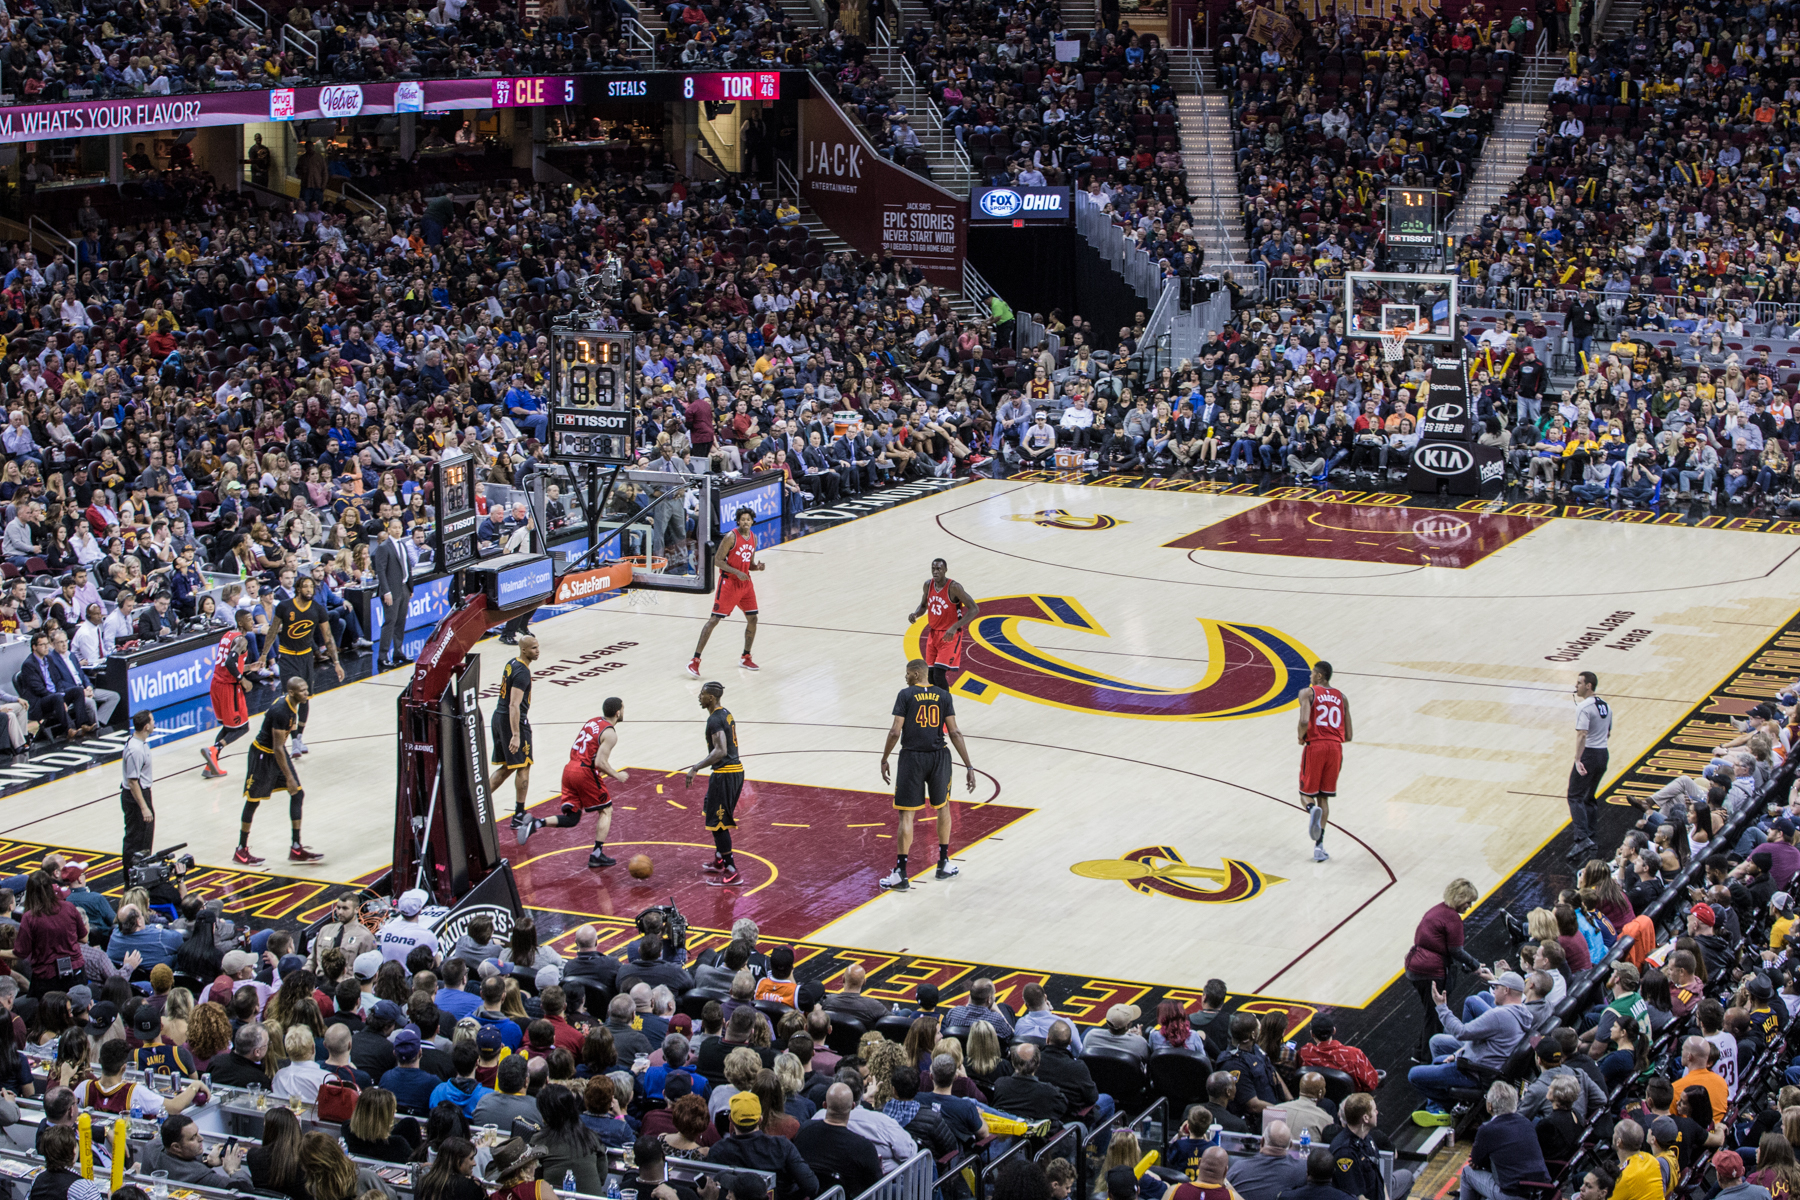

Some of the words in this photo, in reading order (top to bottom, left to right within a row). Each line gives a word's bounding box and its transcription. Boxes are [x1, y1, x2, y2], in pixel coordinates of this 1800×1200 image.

[496, 80, 510, 90] FG%
[608, 81, 647, 96] STEALS
[683, 77, 694, 98] 8
[722, 76, 753, 97] TOR
[760, 74, 775, 83] FG%
[272, 92, 291, 105] drug
[323, 87, 360, 112] Velvet
[497, 90, 509, 105] 37
[515, 79, 545, 104] CLE
[564, 80, 574, 102] 5
[760, 83, 774, 97] 46
[21, 109, 84, 135] WHAT'S
[88, 106, 131, 129] YOUR
[136, 101, 202, 126] FLAVOR?
[274, 105, 294, 117] mart
[811, 181, 858, 194] ENTERTAINMENT
[990, 194, 1013, 206] FOX
[883, 211, 907, 228] EPIC
[910, 213, 955, 231] STORIES
[883, 229, 908, 241] NEVER
[910, 231, 933, 243] START
[935, 232, 955, 244] WITH
[1401, 235, 1433, 243] TISSOT
[893, 243, 912, 251] DECIDED
[920, 244, 926, 252] GO
[927, 245, 940, 253] HOME
[578, 341, 608, 363] 7.1
[1430, 383, 1459, 392] Spectrum
[575, 414, 627, 429] TISSOT
[1424, 449, 1463, 469] KIA
[832, 476, 971, 511] FANDUEL
[1007, 469, 1412, 506] CLEVELAND
[453, 516, 475, 531] TISSOT
[741, 552, 752, 562] 92
[500, 578, 527, 594] Walmart
[931, 604, 942, 616] 43
[1544, 631, 1607, 662] Quicken
[1586, 610, 1635, 631] Loans
[1604, 628, 1653, 651] Arena
[430, 626, 455, 668] SPALDING
[559, 640, 639, 665] Loans
[130, 659, 203, 704] Walmart
[548, 660, 628, 687] Arena
[914, 693, 940, 702] TAVARES
[916, 704, 940, 728] 40
[1315, 704, 1342, 728] 20
[572, 730, 593, 754] 23
[467, 713, 483, 783] Cleveland
[475, 784, 487, 825] Clinic
[384, 932, 416, 946] Bona
[146, 1054, 165, 1066] JAMES
[1718, 1060, 1735, 1087] 23
